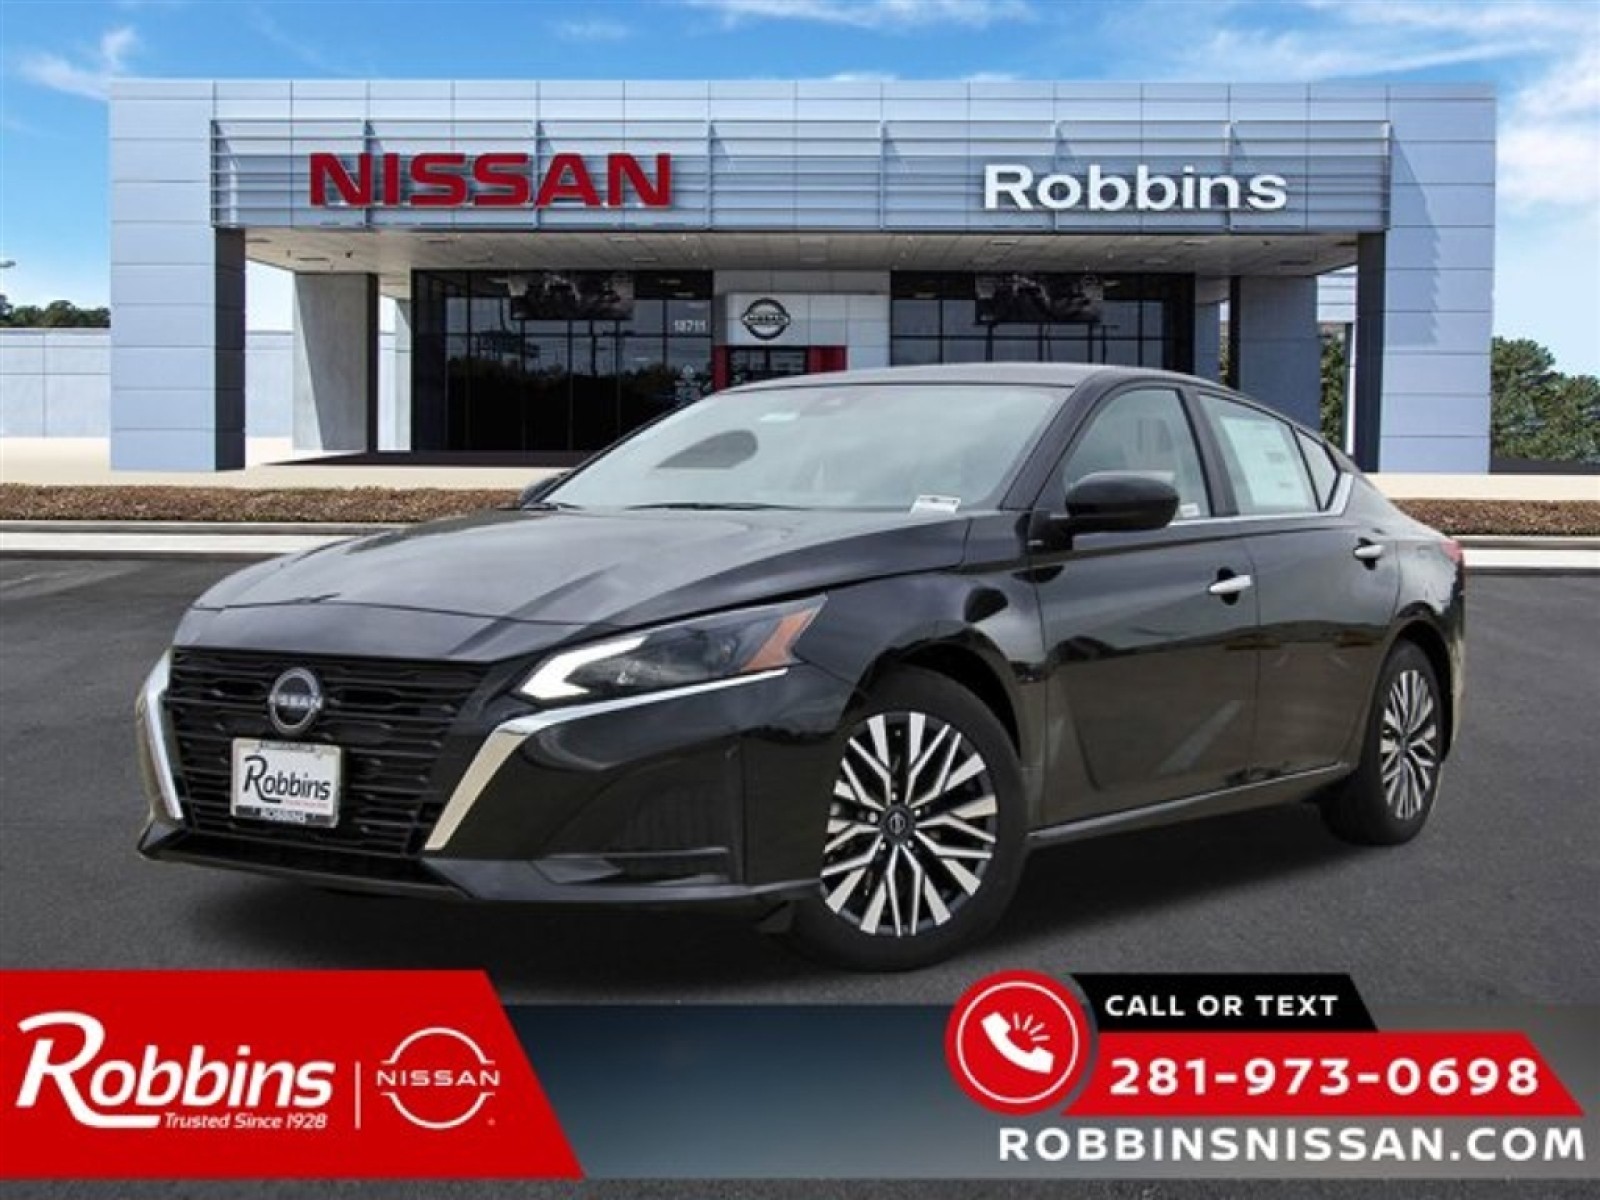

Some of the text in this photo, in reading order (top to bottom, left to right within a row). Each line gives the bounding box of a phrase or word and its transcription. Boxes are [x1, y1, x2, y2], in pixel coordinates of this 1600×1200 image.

[310, 152, 671, 208] NISSAN
[984, 164, 1287, 211] Robbins
[243, 754, 331, 803] Robbins
